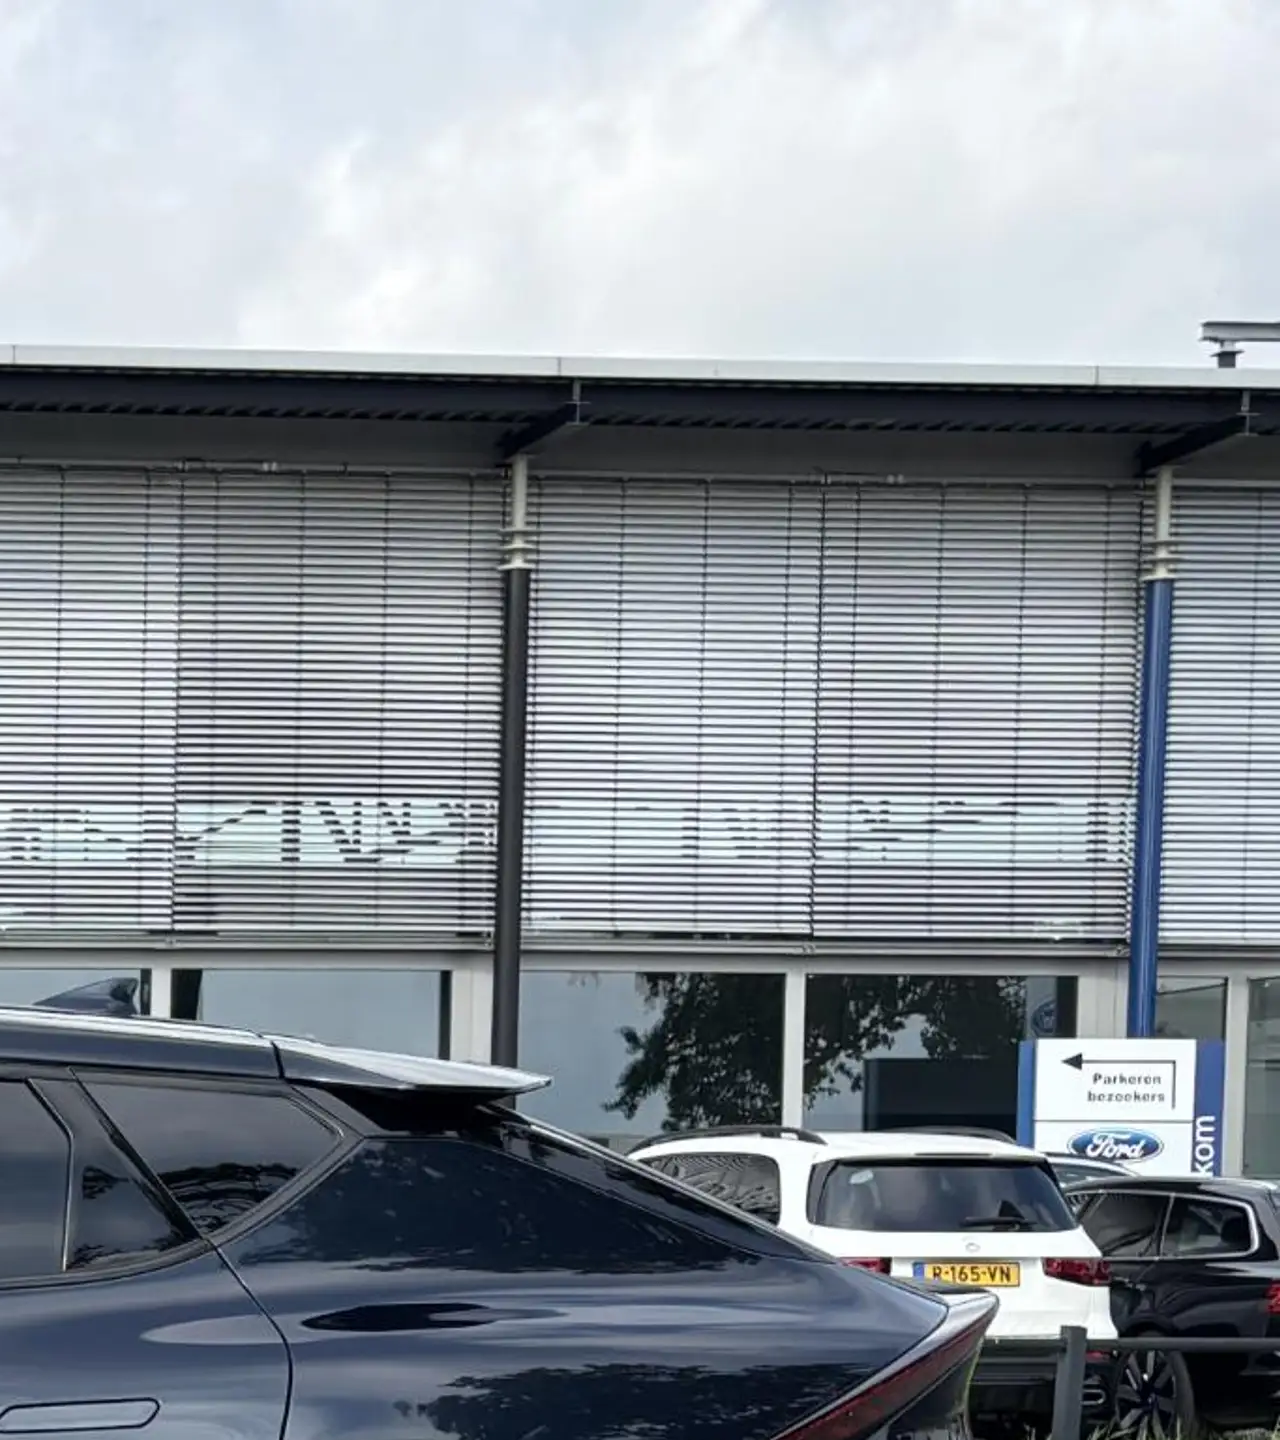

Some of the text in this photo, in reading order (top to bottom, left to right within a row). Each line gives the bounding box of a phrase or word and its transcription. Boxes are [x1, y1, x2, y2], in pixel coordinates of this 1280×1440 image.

[1092, 1072, 1162, 1085] Parkeren
[1086, 1090, 1166, 1103] bezoekers
[1085, 1132, 1146, 1159] Ford
[932, 1265, 1012, 1283] R-165-VN
